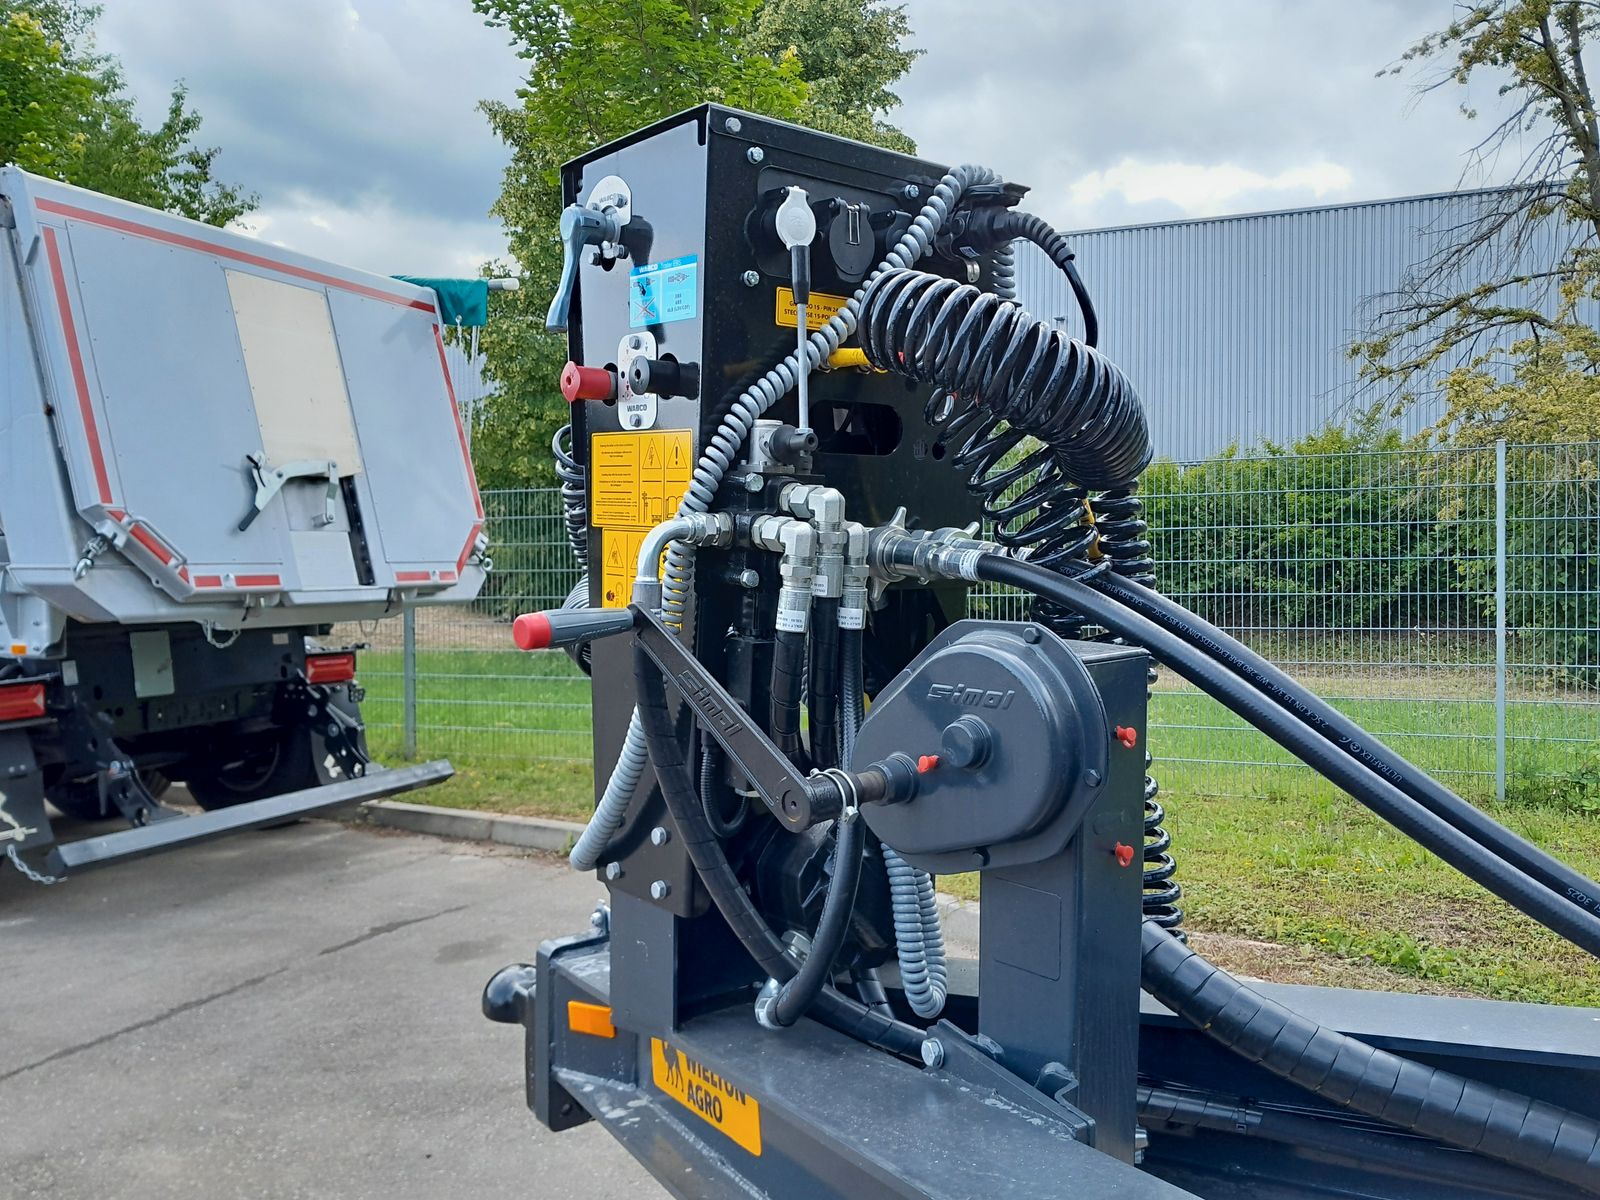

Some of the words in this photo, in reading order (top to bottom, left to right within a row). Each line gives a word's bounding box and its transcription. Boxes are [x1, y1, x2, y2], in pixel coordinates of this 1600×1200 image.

[626, 404, 648, 412] WABCO
[1178, 622, 1188, 631] EN
[1187, 628, 1200, 640] DIN
[1200, 636, 1230, 658] EXCEEDS
[1228, 655, 1244, 668] BAR
[1242, 664, 1258, 677] 280
[1256, 675, 1270, 686] WP
[1284, 694, 1295, 704] 19
[1294, 700, 1307, 712] DN
[1361, 750, 1403, 782] ULTRAFLEX
[1567, 887, 1592, 906] 3Q25
[687, 1079, 722, 1124] AGRO
